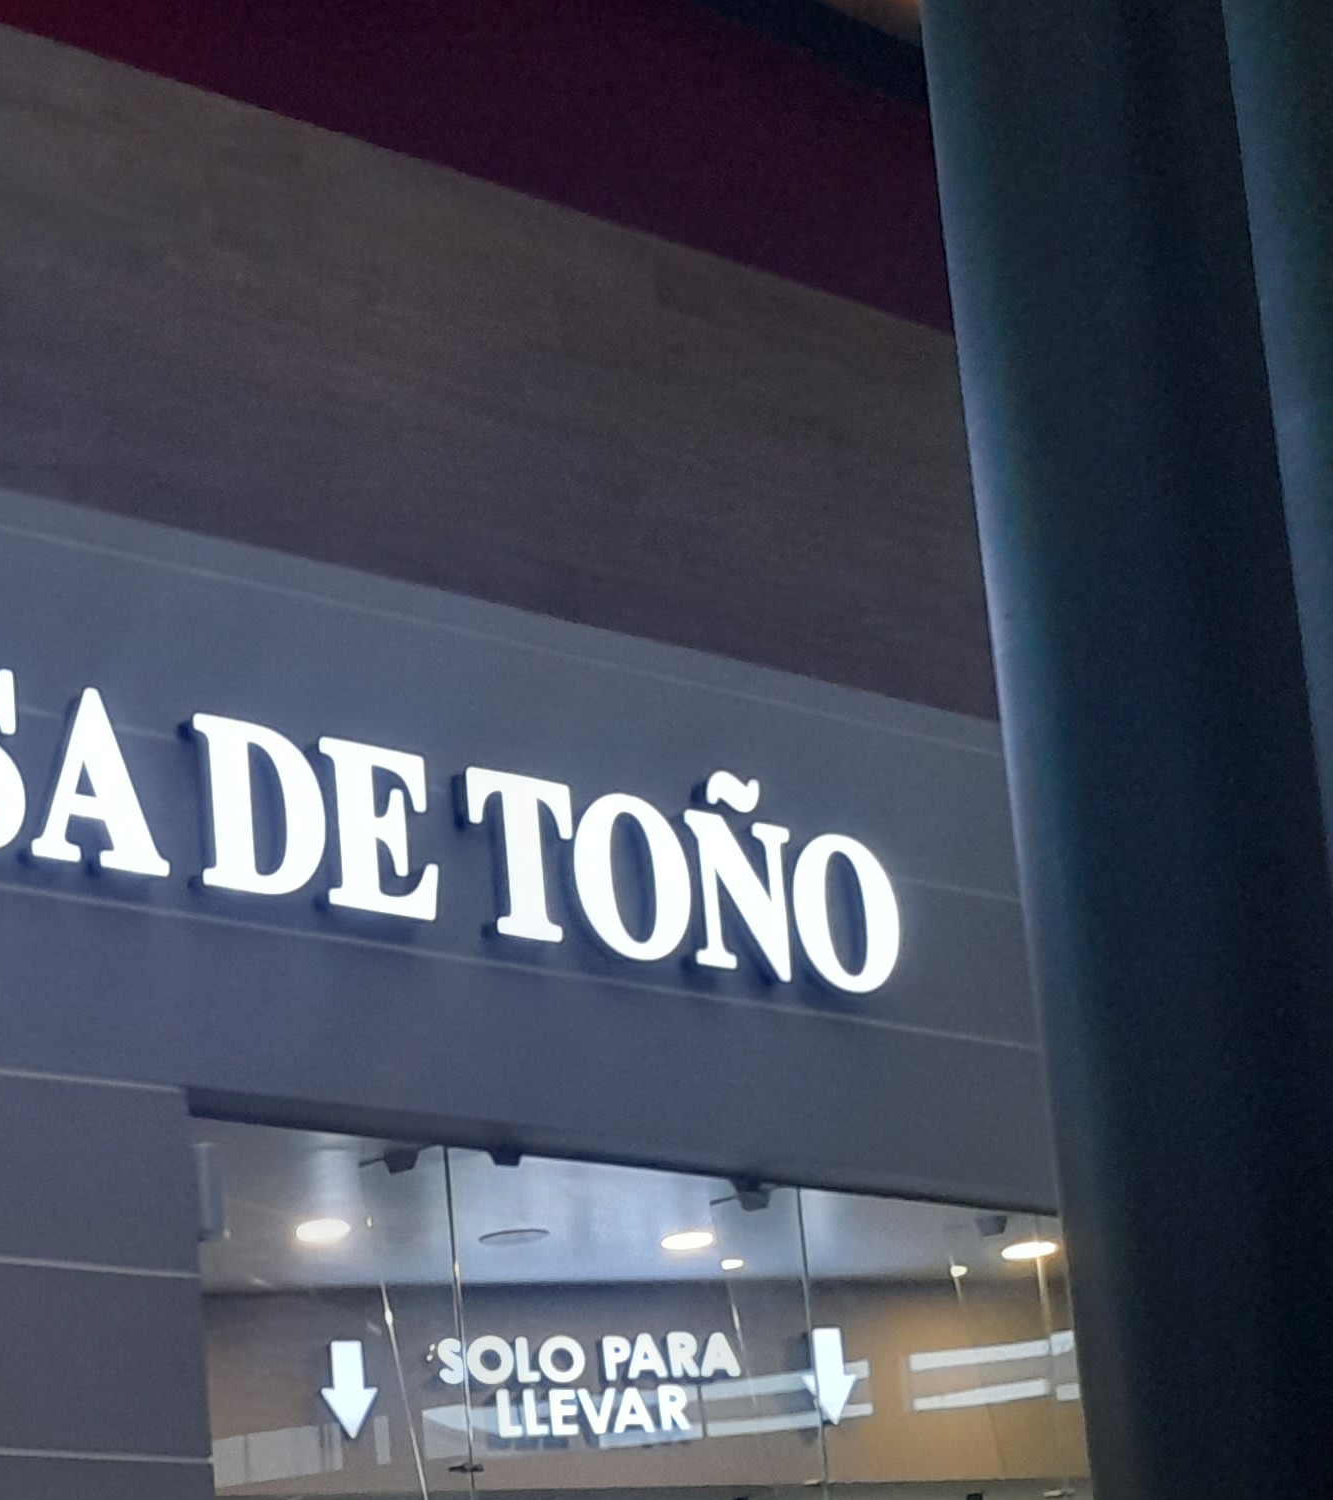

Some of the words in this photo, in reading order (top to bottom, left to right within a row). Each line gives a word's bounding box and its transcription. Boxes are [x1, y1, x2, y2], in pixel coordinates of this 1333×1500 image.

[192, 711, 439, 921] DE
[465, 770, 900, 994] TOÑO
[437, 1335, 585, 1385] SOLO
[602, 1331, 741, 1382] PARA
[495, 1384, 691, 1438] LLEVAR
